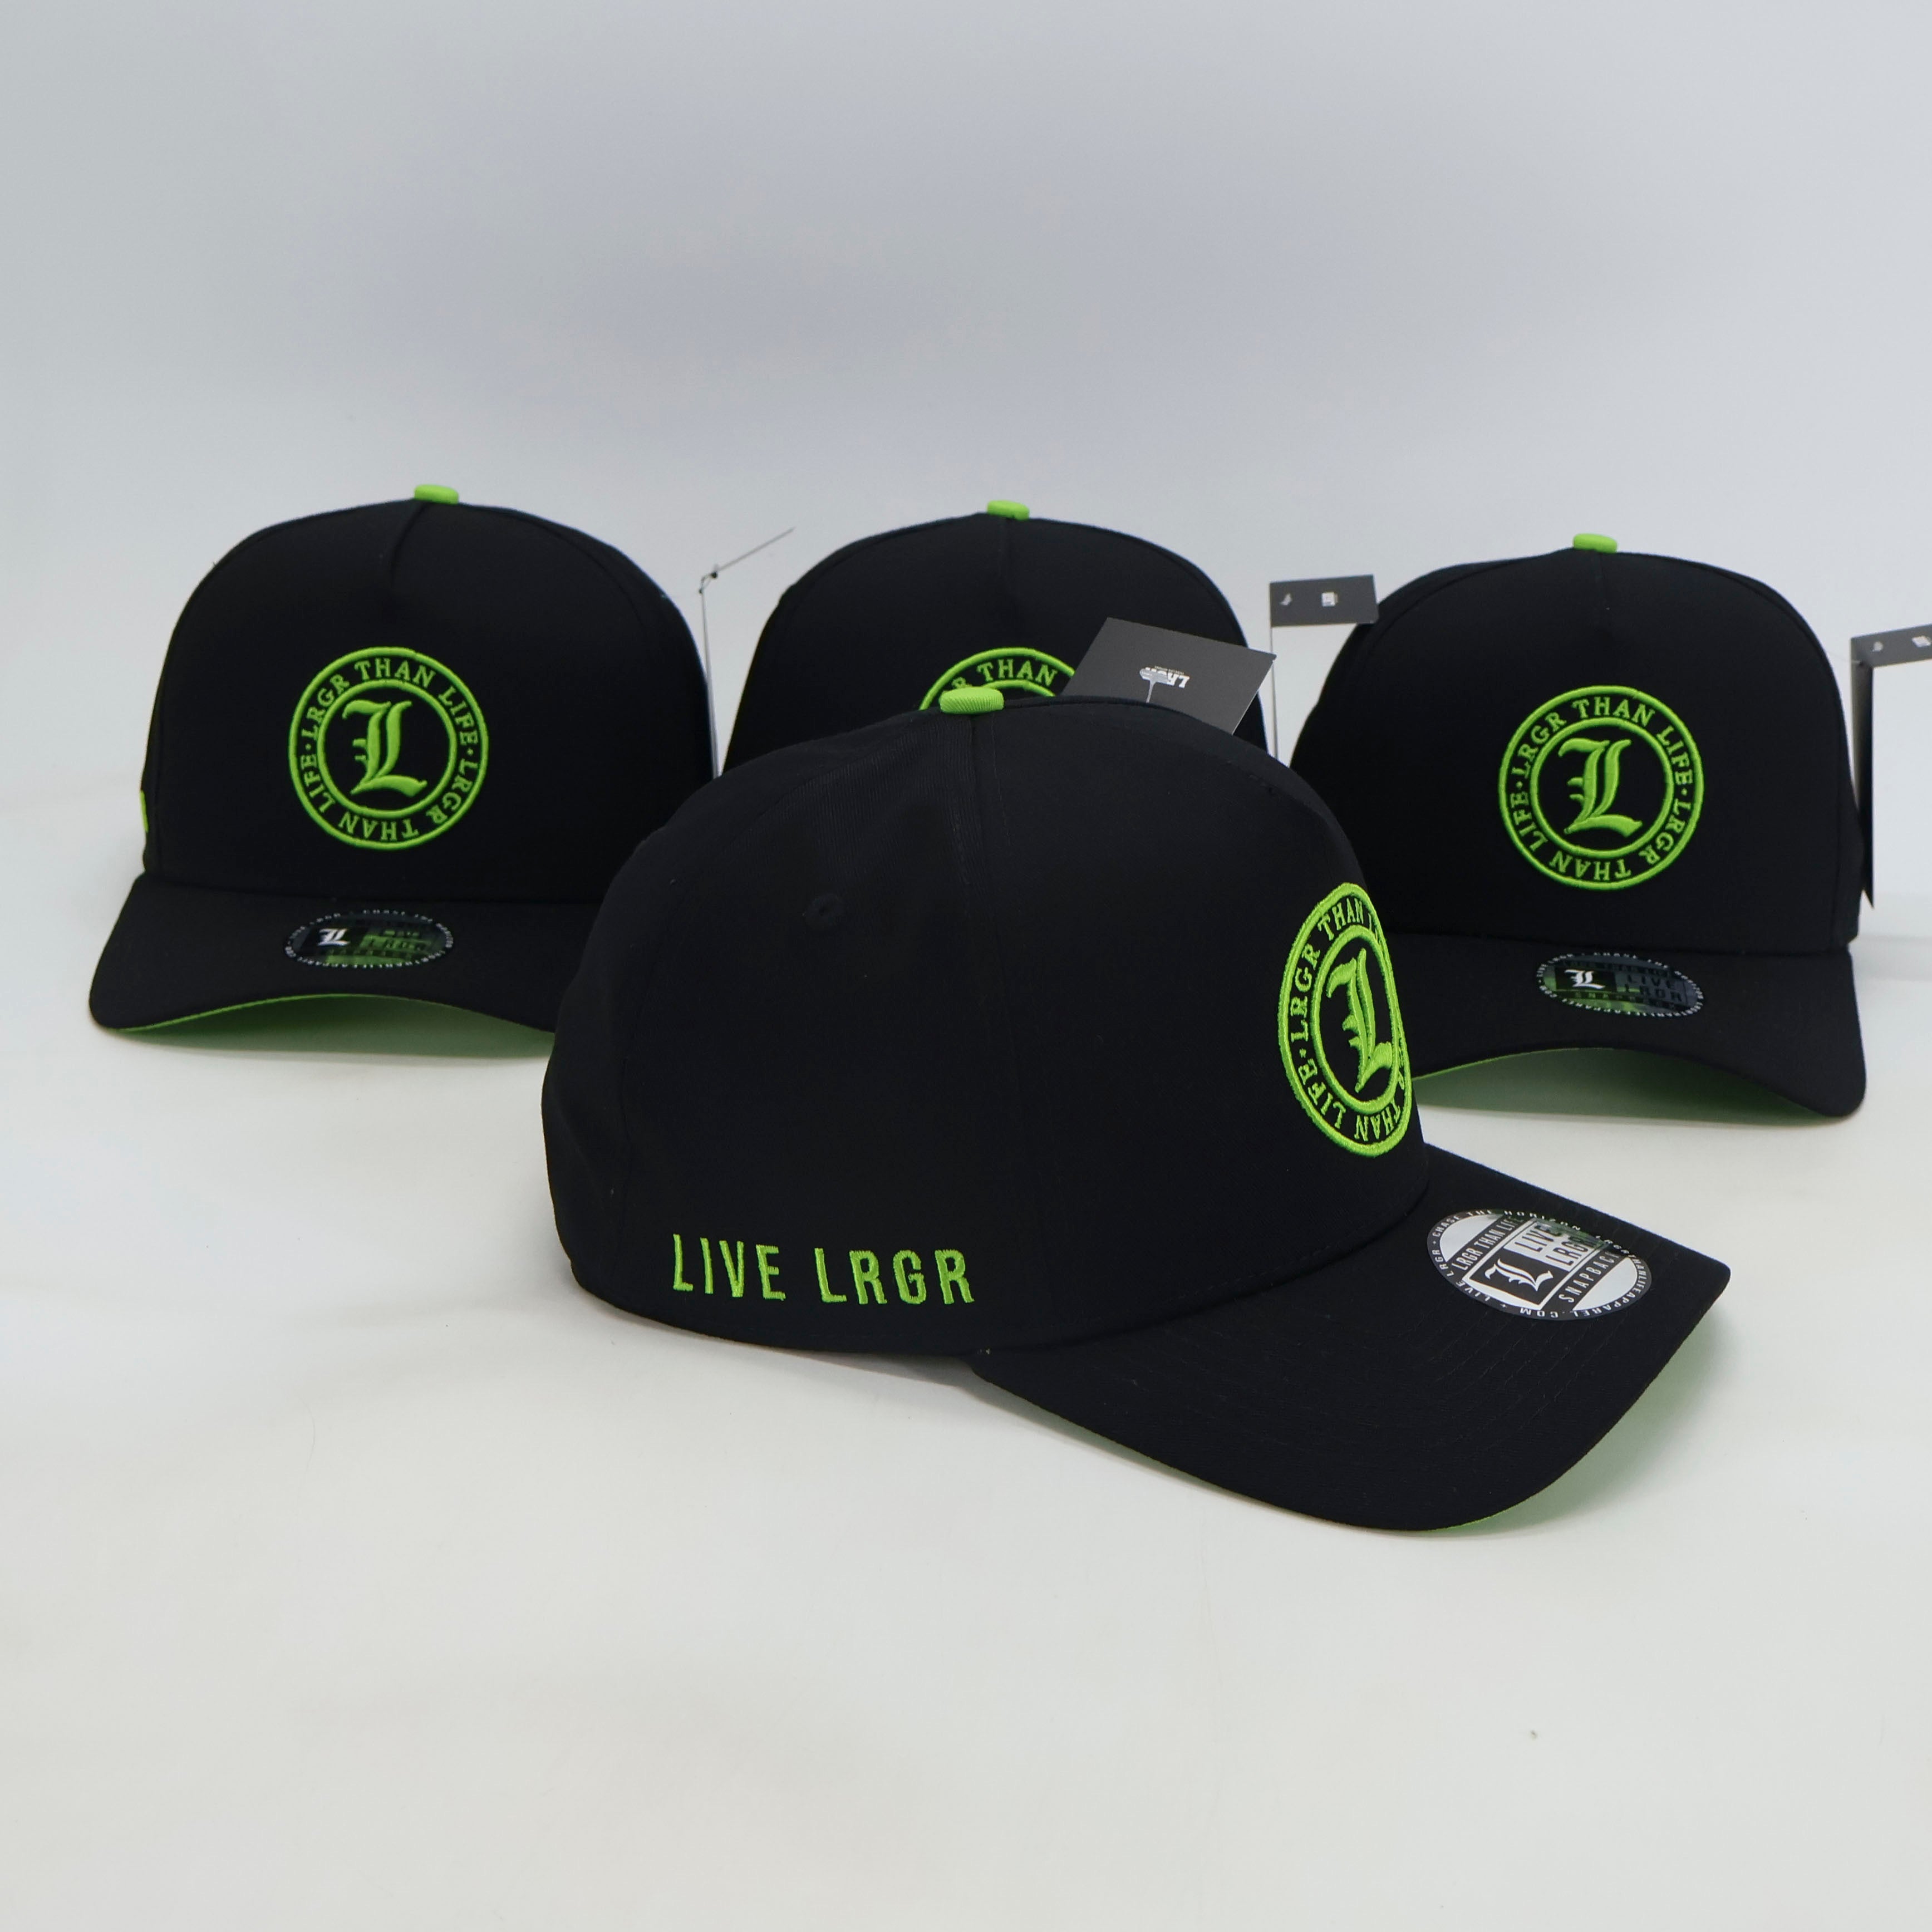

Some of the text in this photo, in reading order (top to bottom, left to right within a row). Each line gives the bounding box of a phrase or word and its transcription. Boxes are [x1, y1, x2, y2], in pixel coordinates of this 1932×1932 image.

[301, 658, 479, 745] LRGR THAN LIFE
[977, 659, 1058, 686] THAN
[1511, 696, 1693, 785] LRGR THAN LIFE
[301, 754, 479, 841] LRGR THAN LIFE
[1510, 792, 1691, 881] LRGR THAN LIFE
[1291, 898, 1364, 1043] LRGR THAN
[1297, 1059, 1346, 1129] LIFE
[673, 1233, 975, 1304] LIVE LRGR
[1432, 1250, 1491, 1301] LIVE LRGR
[1452, 1247, 1483, 1270] LRGR
[1474, 1229, 1506, 1248] THAN
